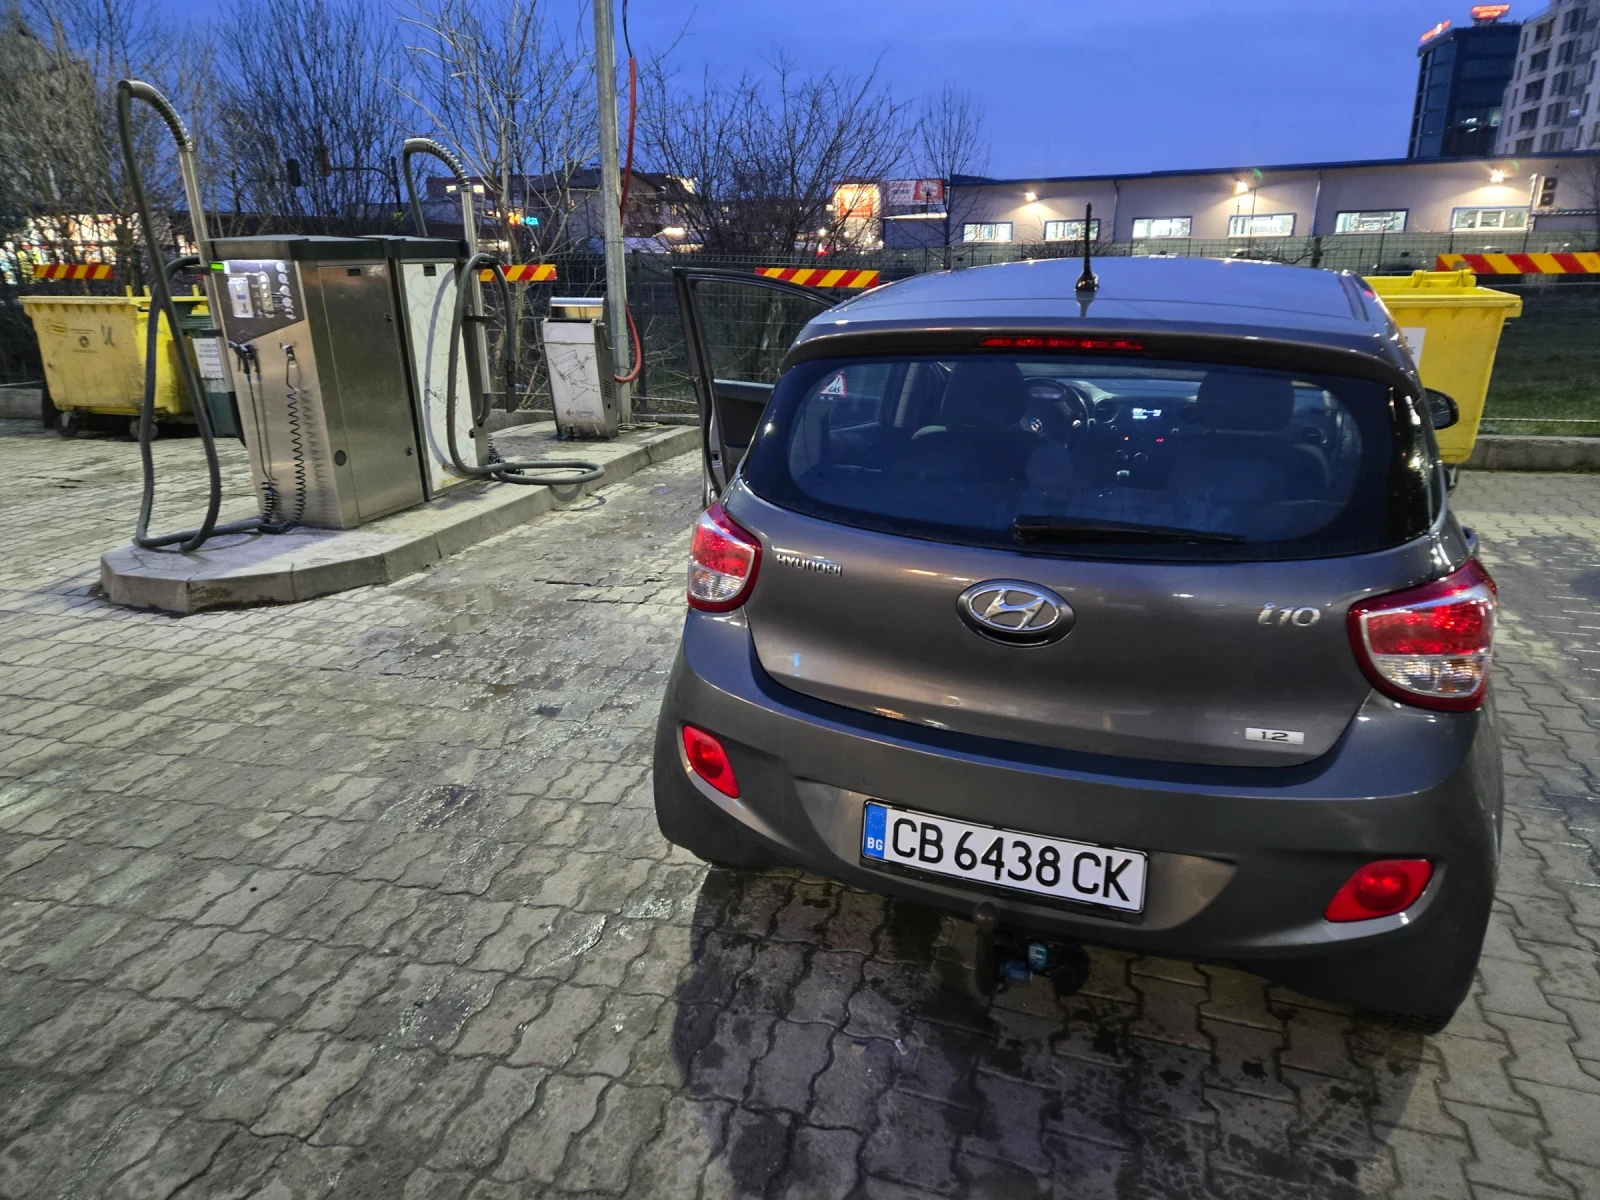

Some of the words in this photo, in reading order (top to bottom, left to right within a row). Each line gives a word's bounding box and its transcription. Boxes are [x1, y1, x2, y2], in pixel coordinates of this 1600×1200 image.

[776, 553, 843, 577] HYUNDAI
[1257, 602, 1321, 627] i10
[1261, 730, 1289, 742] 1.2
[867, 837, 883, 851] BG
[892, 817, 944, 865] CB
[954, 831, 1061, 888] 6438
[1072, 851, 1133, 903] CK
